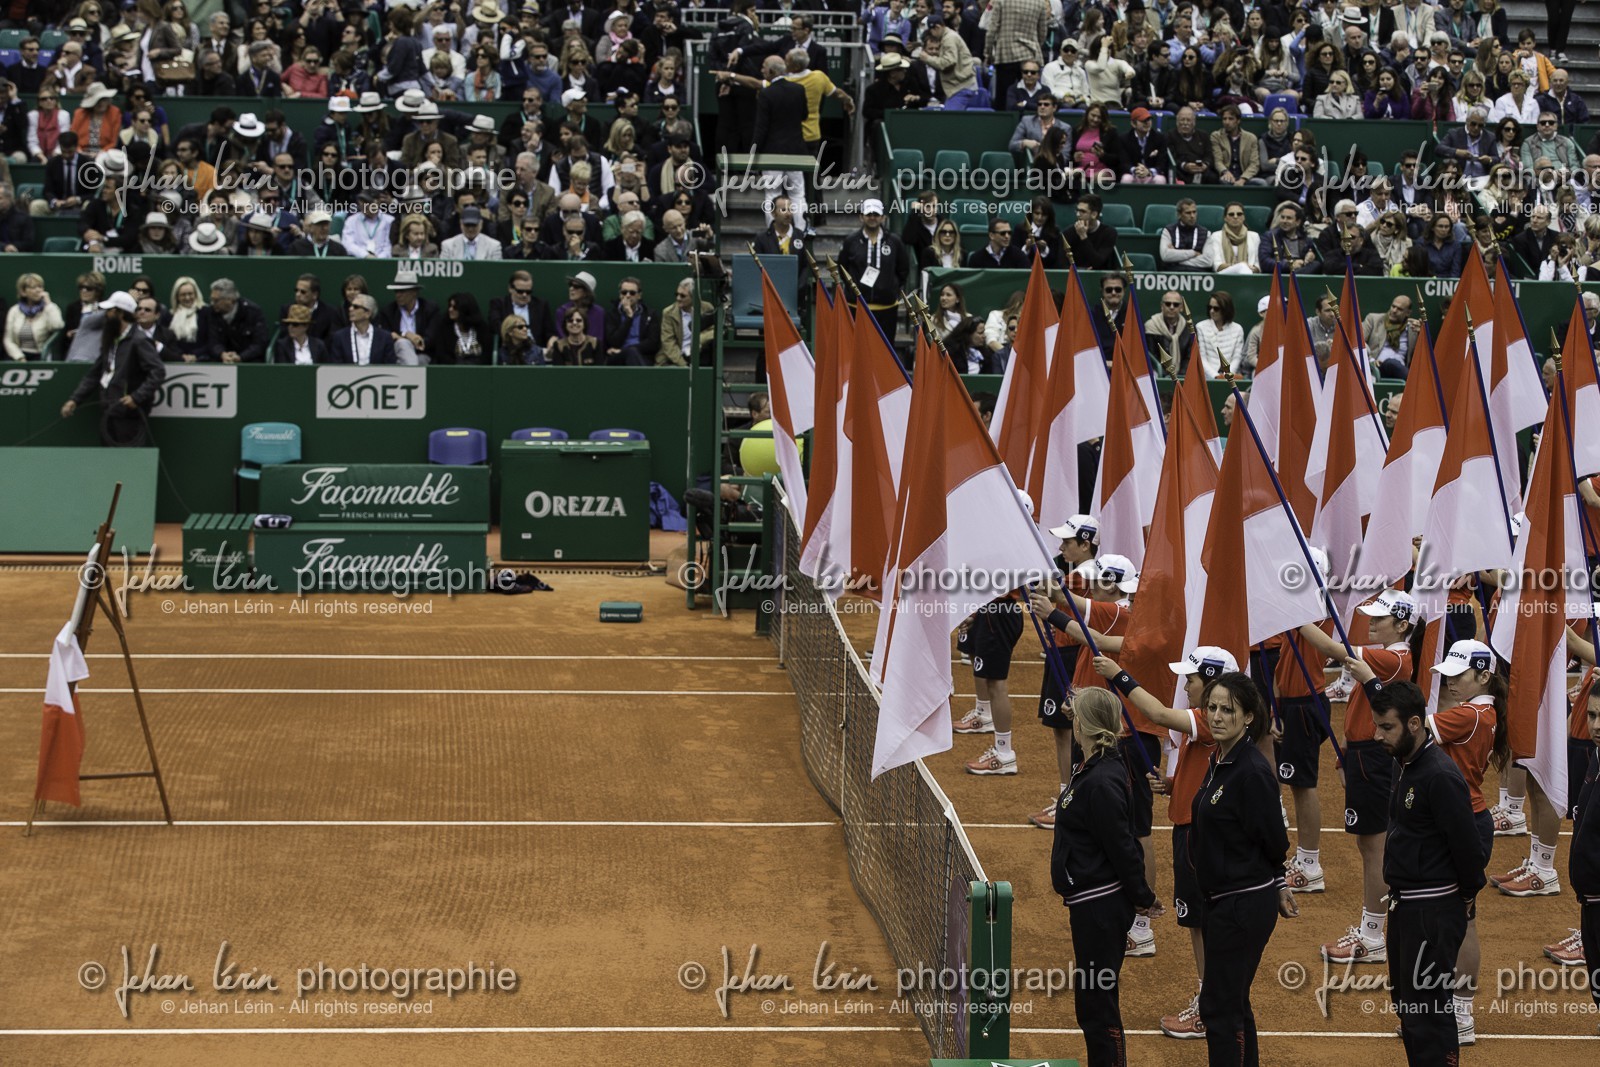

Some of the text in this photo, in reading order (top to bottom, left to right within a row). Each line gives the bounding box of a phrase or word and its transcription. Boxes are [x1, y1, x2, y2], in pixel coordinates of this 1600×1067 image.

[93, 256, 143, 273] ROME
[398, 260, 464, 277] MADRID
[1133, 274, 1215, 292] TORONTO
[0, 369, 54, 386] OP
[291, 467, 460, 510] Façonnable
[525, 490, 627, 518] OREZZA
